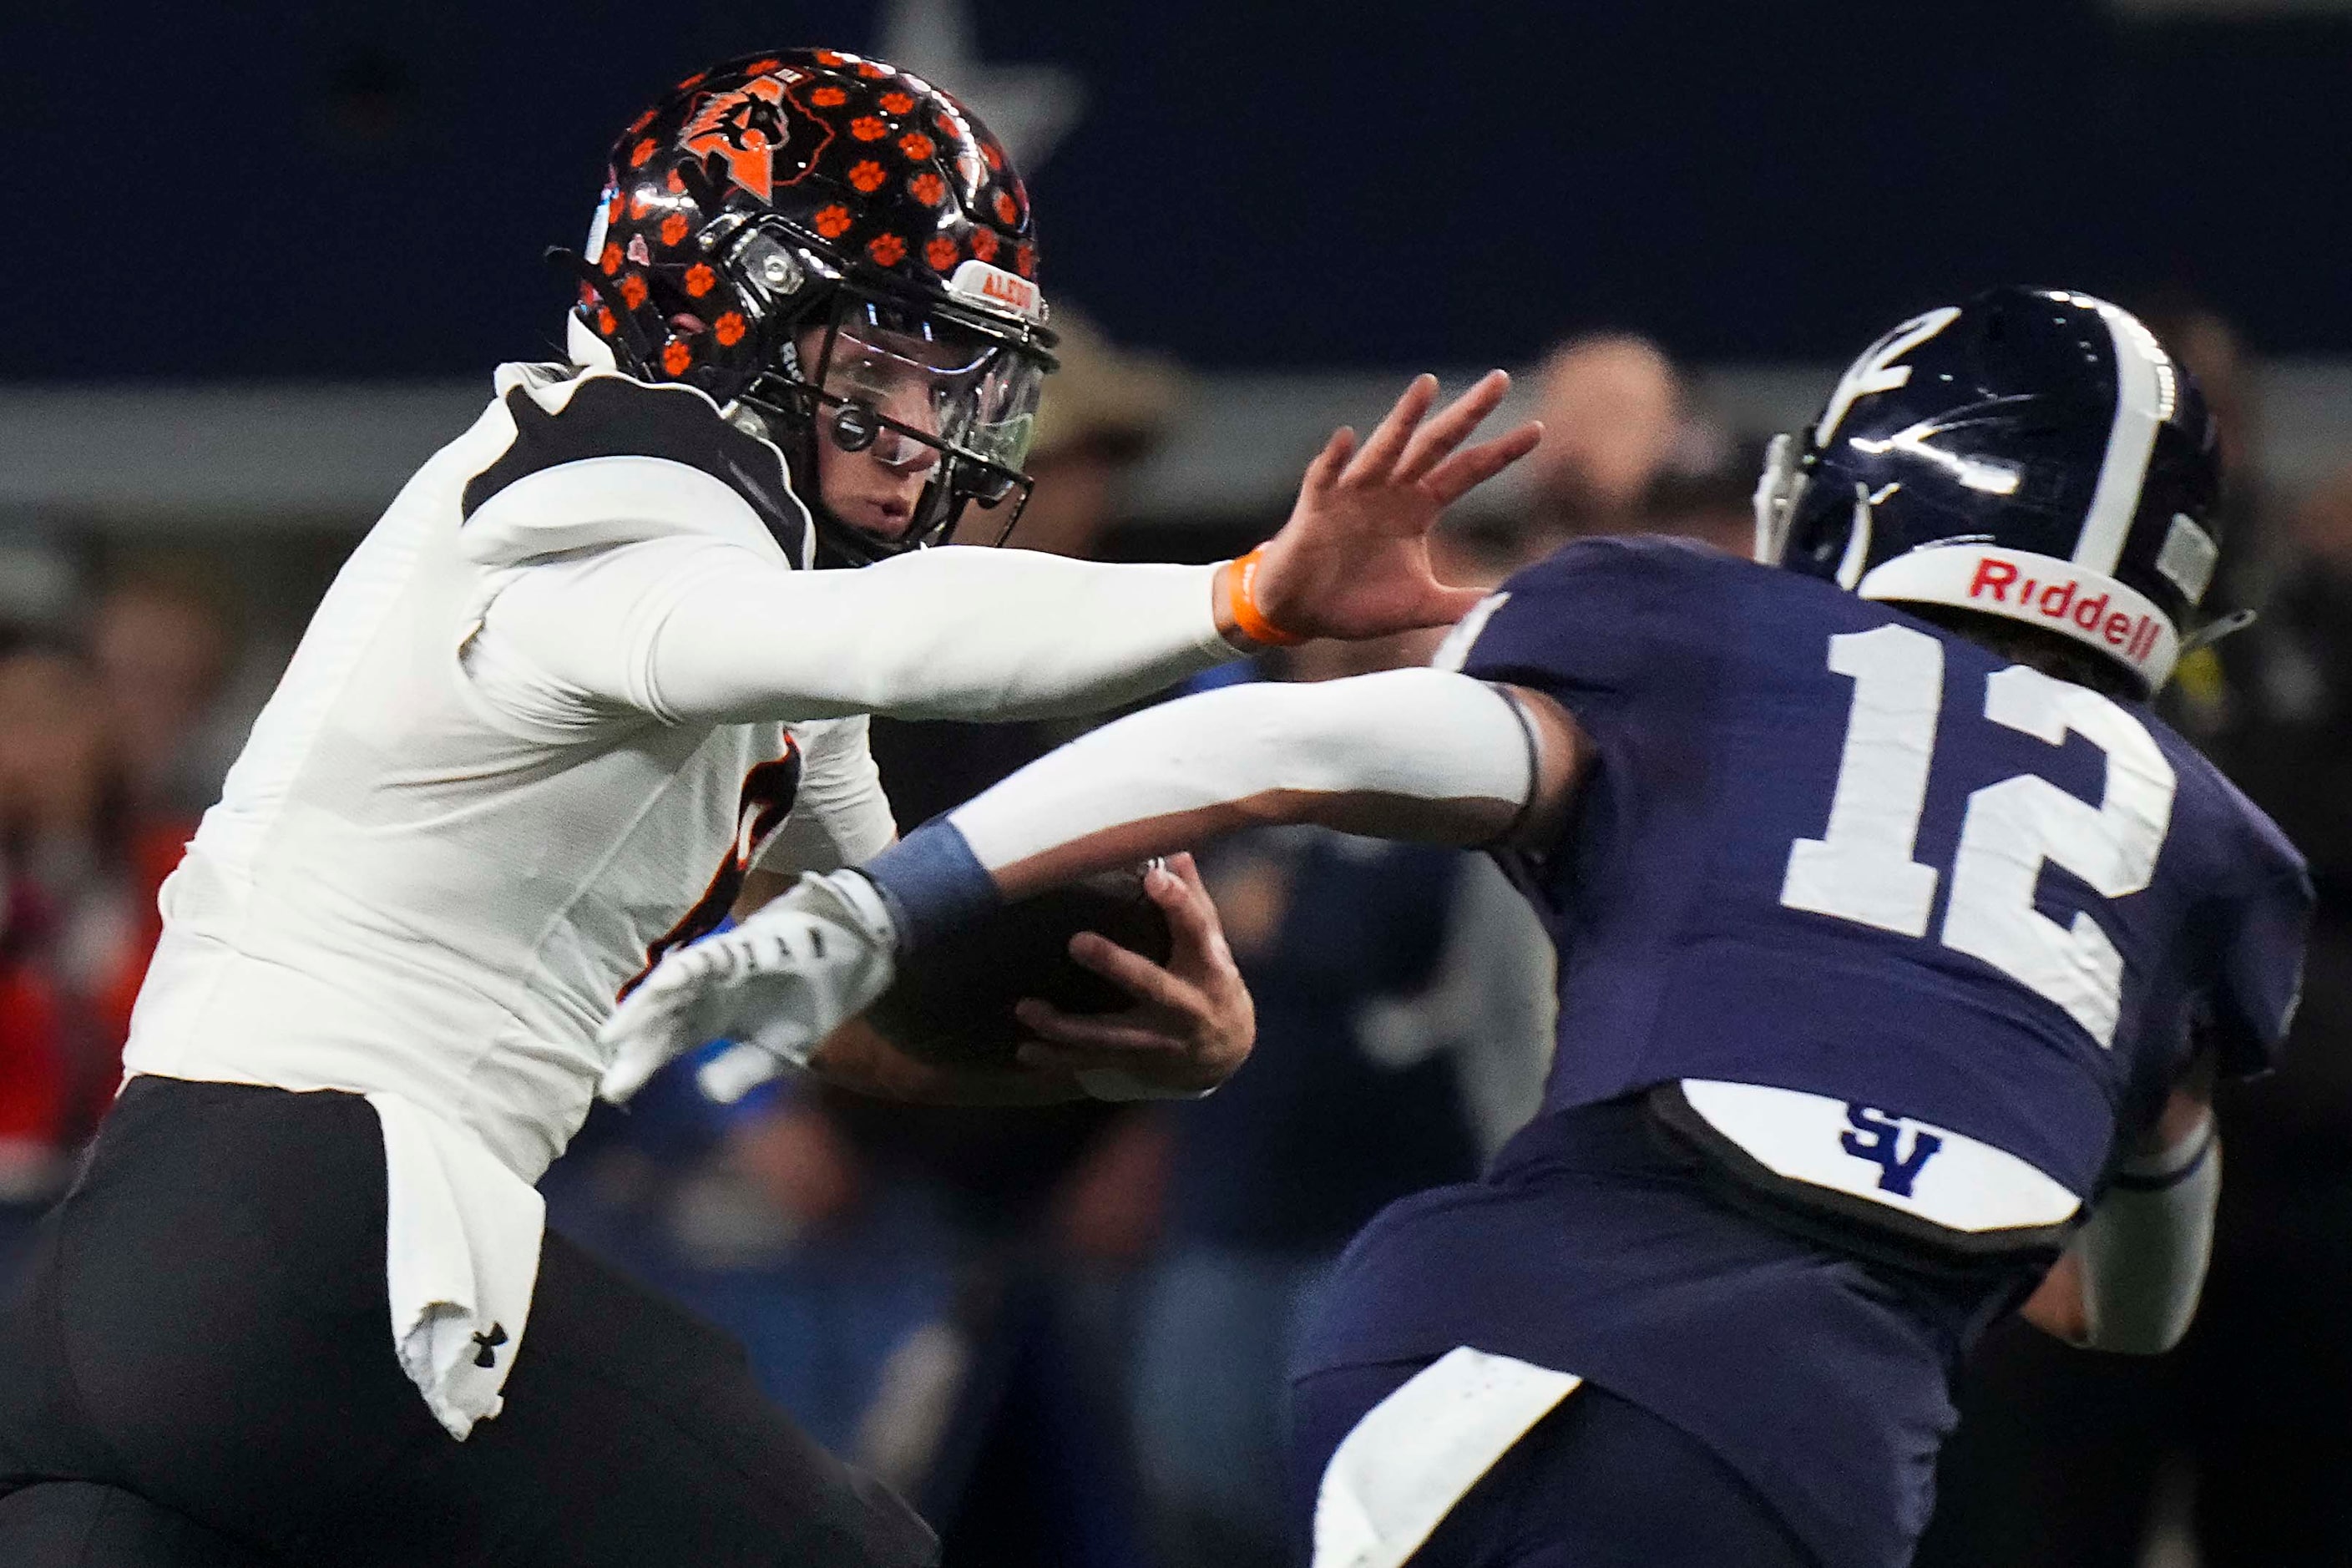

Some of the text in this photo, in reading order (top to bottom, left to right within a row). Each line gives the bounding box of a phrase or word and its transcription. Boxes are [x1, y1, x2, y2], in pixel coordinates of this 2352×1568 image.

[1969, 557, 2161, 662] Riddell
[1780, 623, 2177, 1050] 12
[1840, 1102, 1941, 1197] SV
